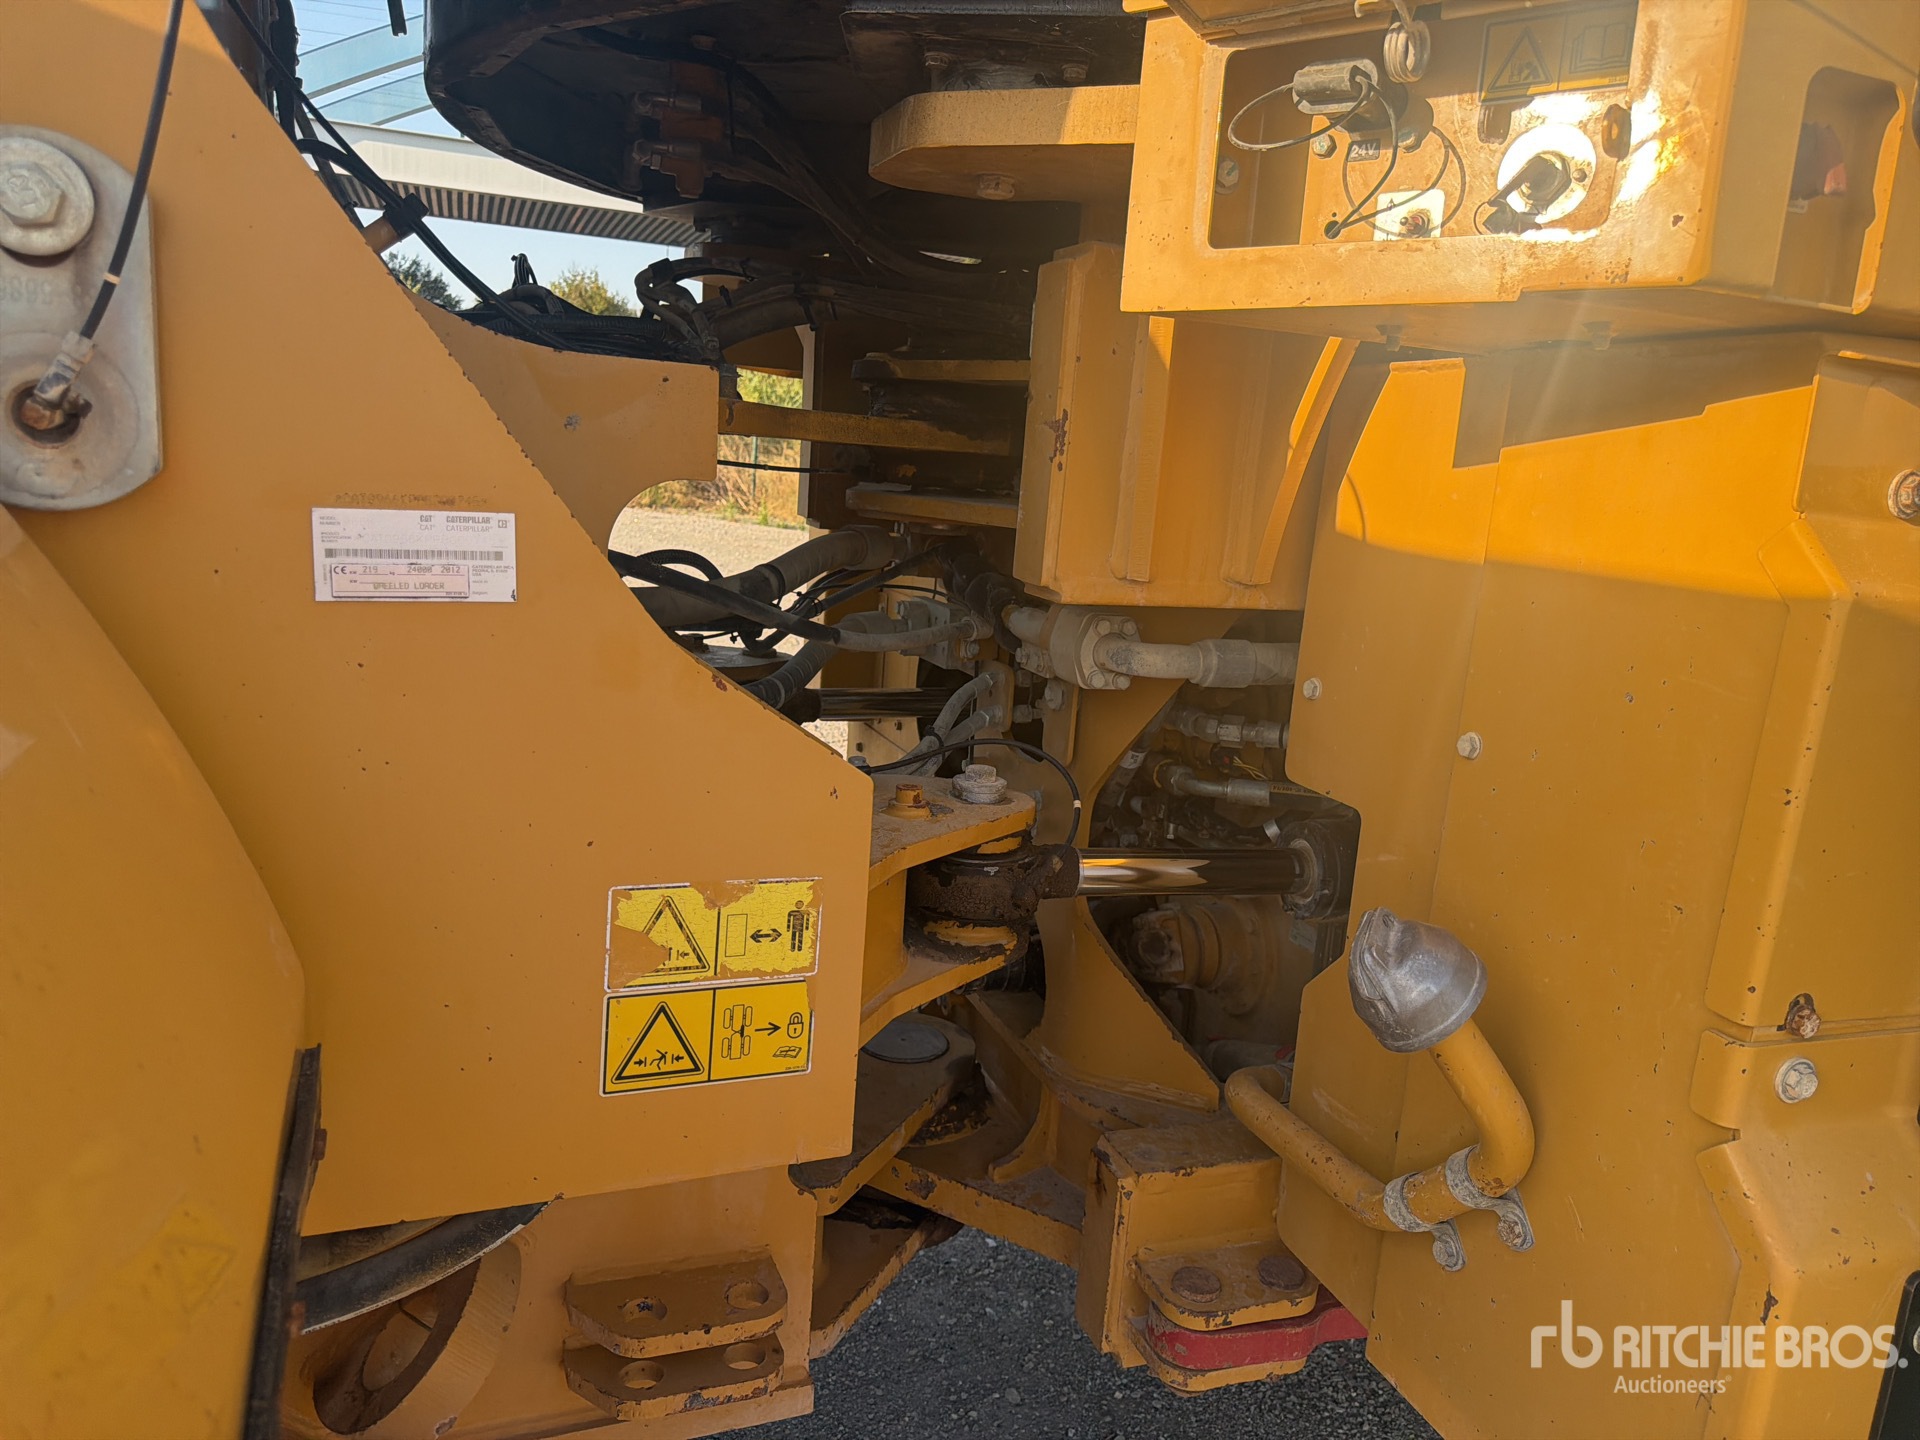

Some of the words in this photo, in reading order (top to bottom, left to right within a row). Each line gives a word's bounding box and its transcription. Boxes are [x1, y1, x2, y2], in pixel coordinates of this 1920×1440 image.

[1351, 143, 1376, 158] 24V
[446, 516, 491, 524] CATERPILLAR
[446, 525, 490, 533] CATERPILLAR
[362, 565, 378, 574] 219
[407, 565, 432, 574] 24000
[440, 565, 461, 574] 2012
[414, 582, 445, 590] LOADER
